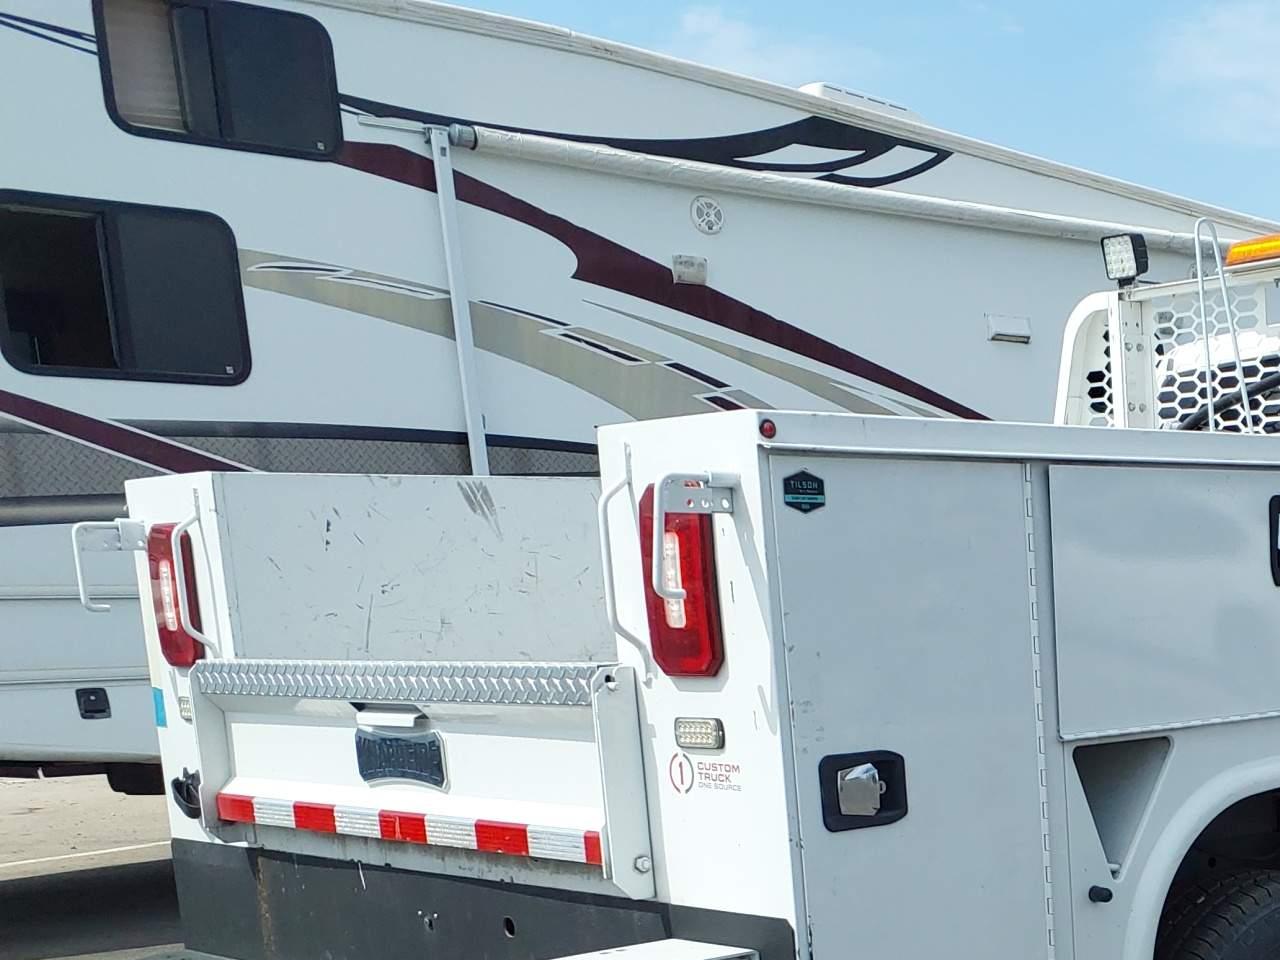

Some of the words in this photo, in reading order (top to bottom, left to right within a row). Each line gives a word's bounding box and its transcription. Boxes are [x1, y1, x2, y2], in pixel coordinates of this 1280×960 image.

[697, 761, 741, 774] CUSTOM
[697, 772, 732, 783] TRUCK
[713, 783, 742, 792] SOURCE
